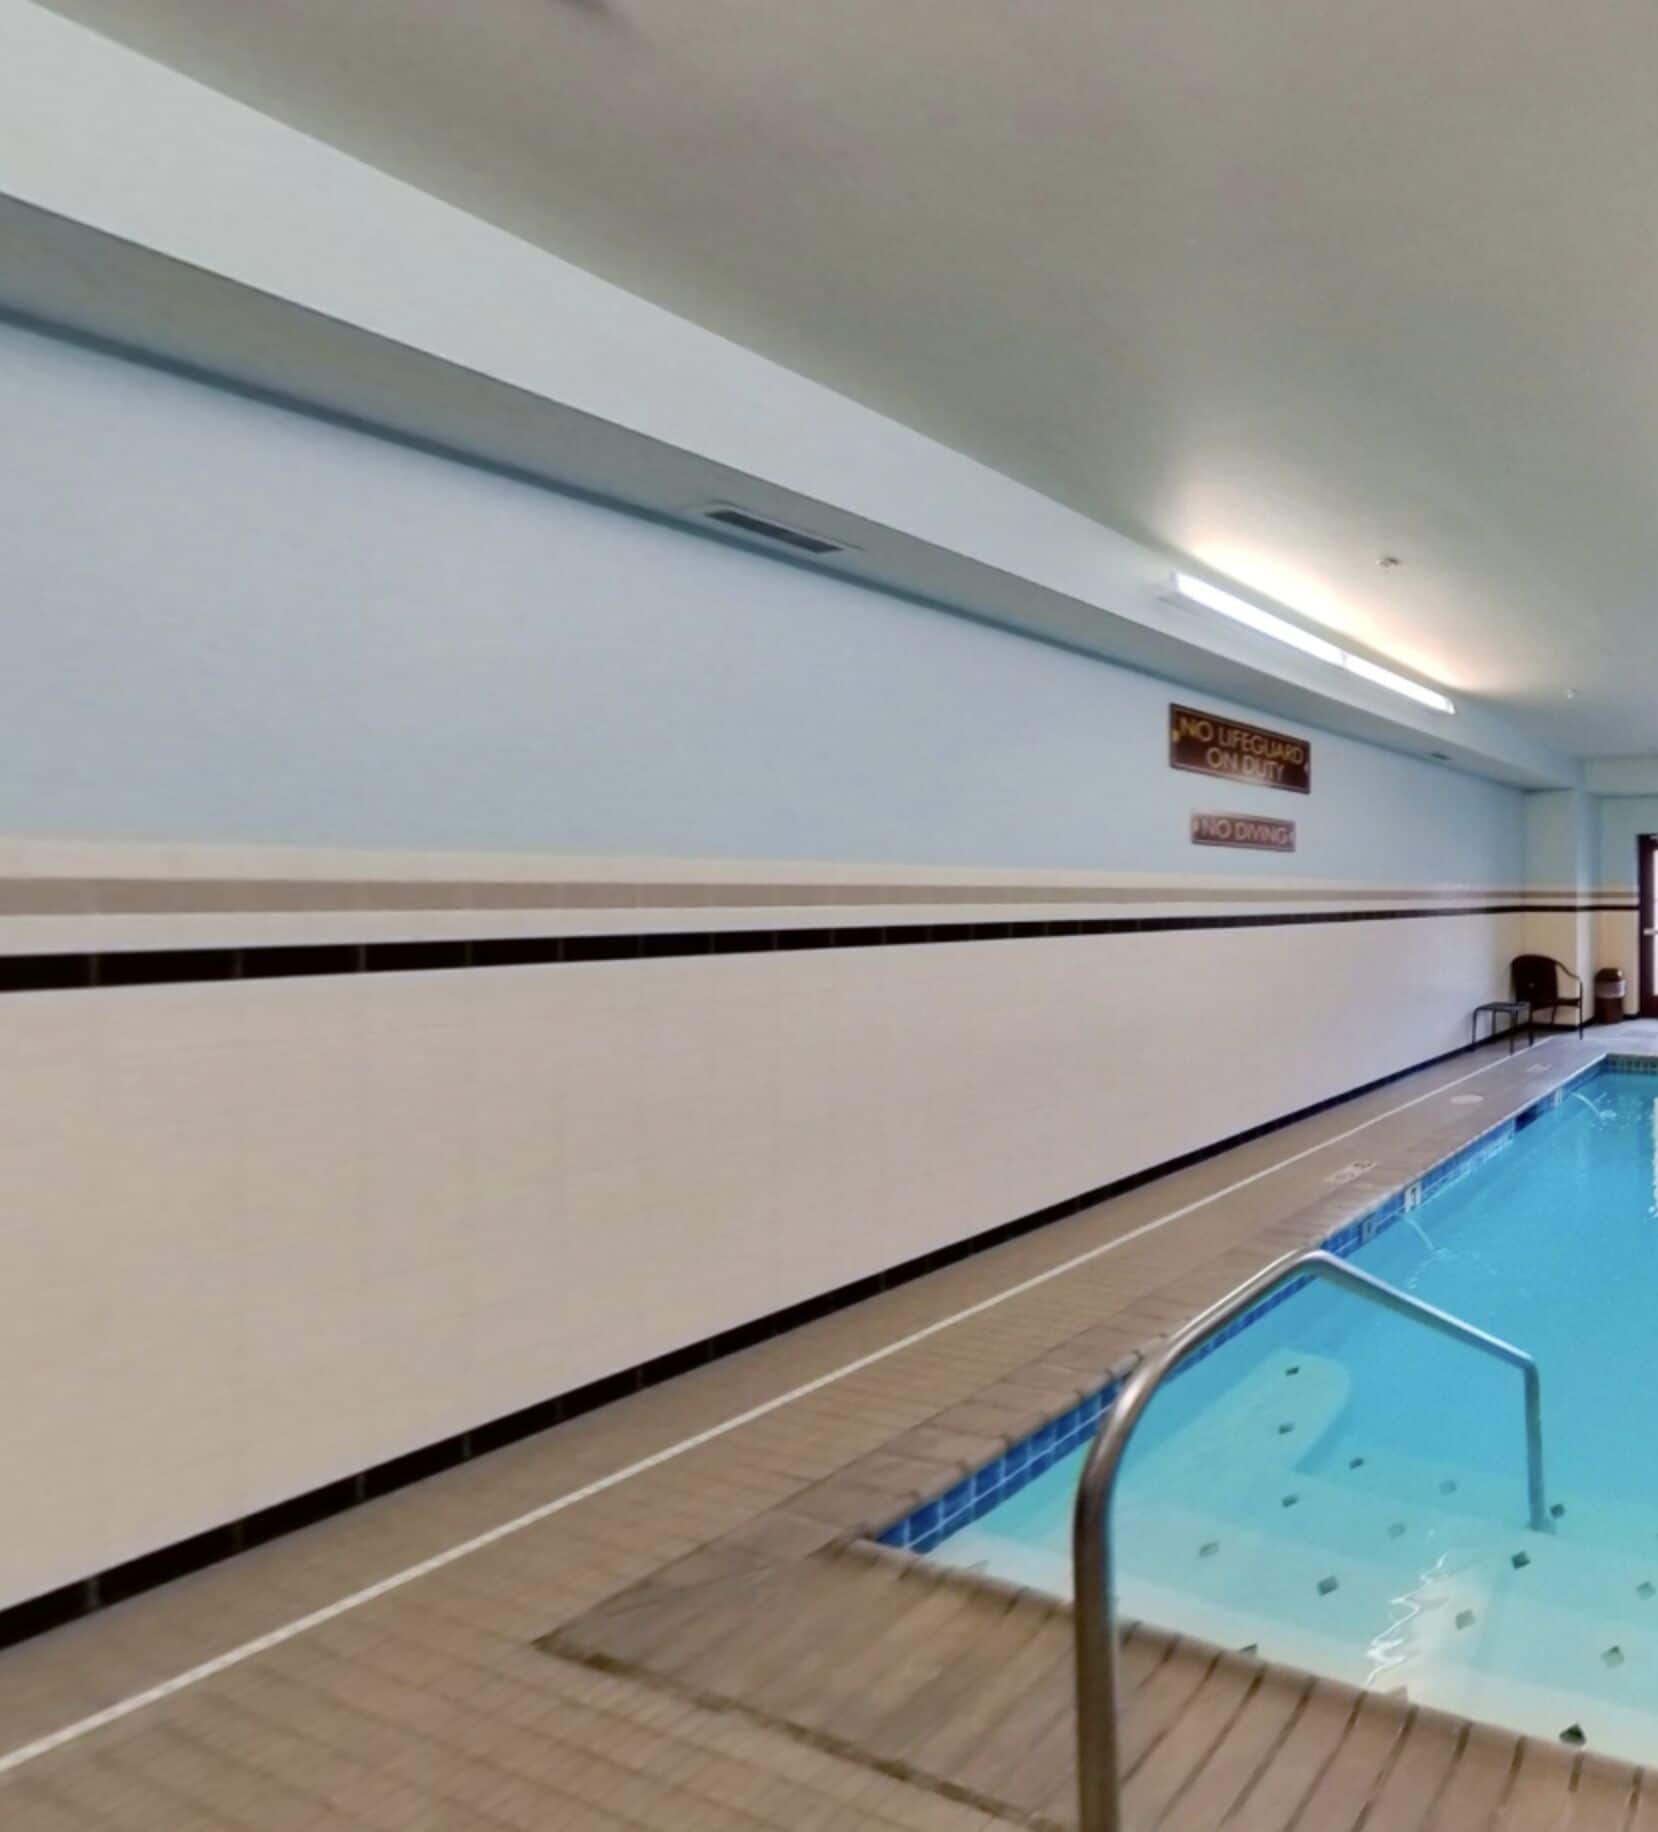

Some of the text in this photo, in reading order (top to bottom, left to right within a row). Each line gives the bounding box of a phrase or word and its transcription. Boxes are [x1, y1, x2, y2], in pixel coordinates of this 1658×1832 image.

[1178, 716, 1305, 765] NO LIFEGUARD
[1205, 746, 1285, 783] ON DUTY
[1201, 817, 1289, 845] NO DIVING
